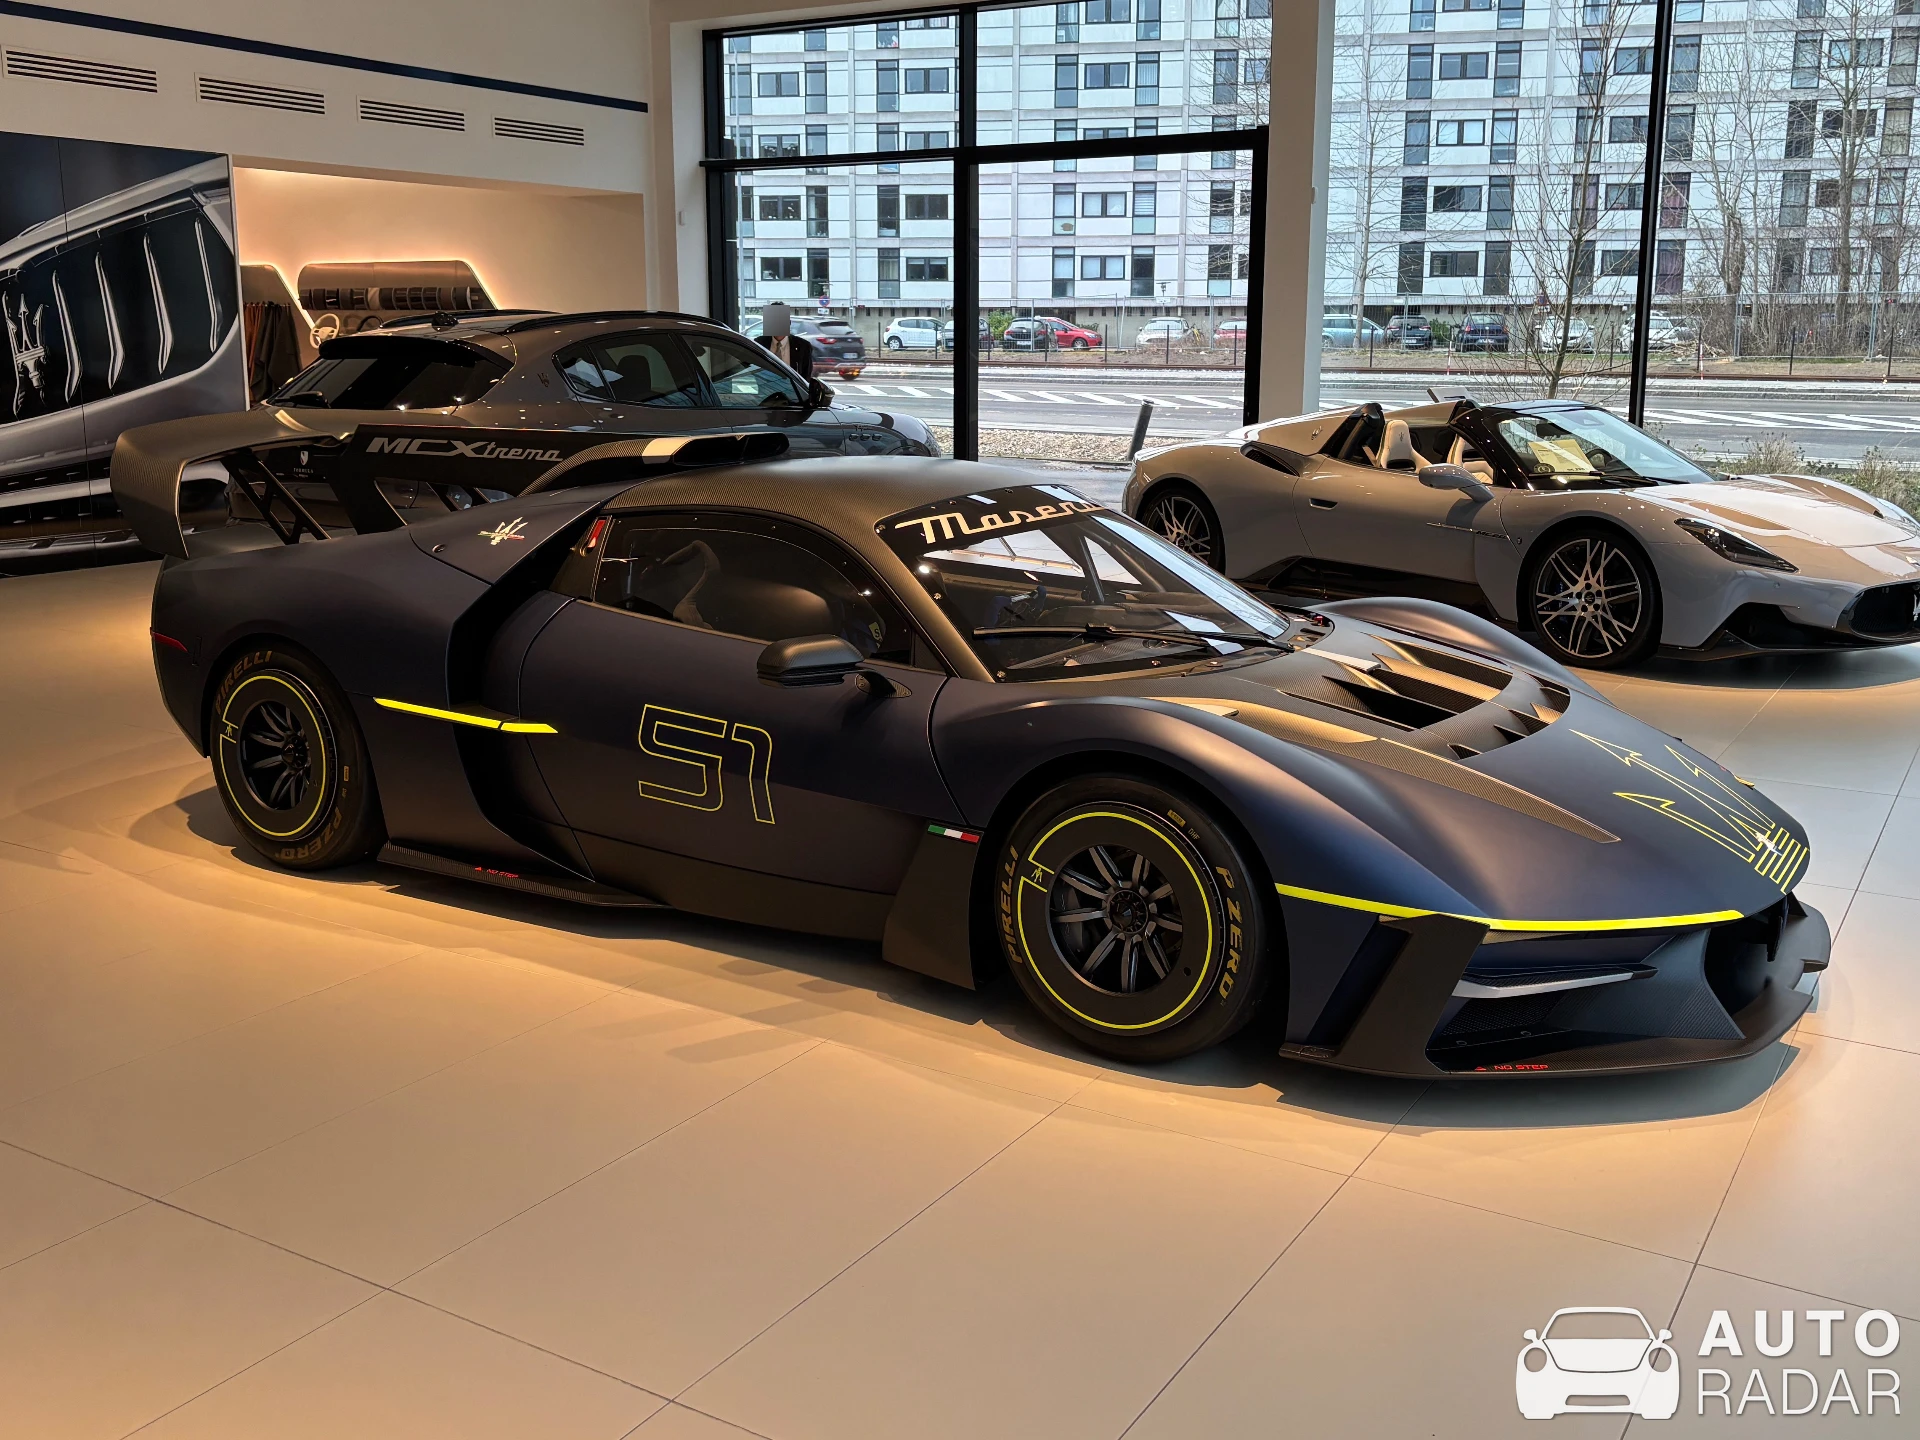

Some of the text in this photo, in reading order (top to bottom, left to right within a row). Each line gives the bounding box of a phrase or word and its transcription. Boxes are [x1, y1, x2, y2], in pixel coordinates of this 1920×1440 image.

[366, 437, 563, 462] MCXtrema
[215, 651, 273, 715] PIRELLI
[638, 704, 775, 824] 51
[1001, 845, 1024, 965] PIRELLI
[1215, 866, 1243, 1000] P ZERO
